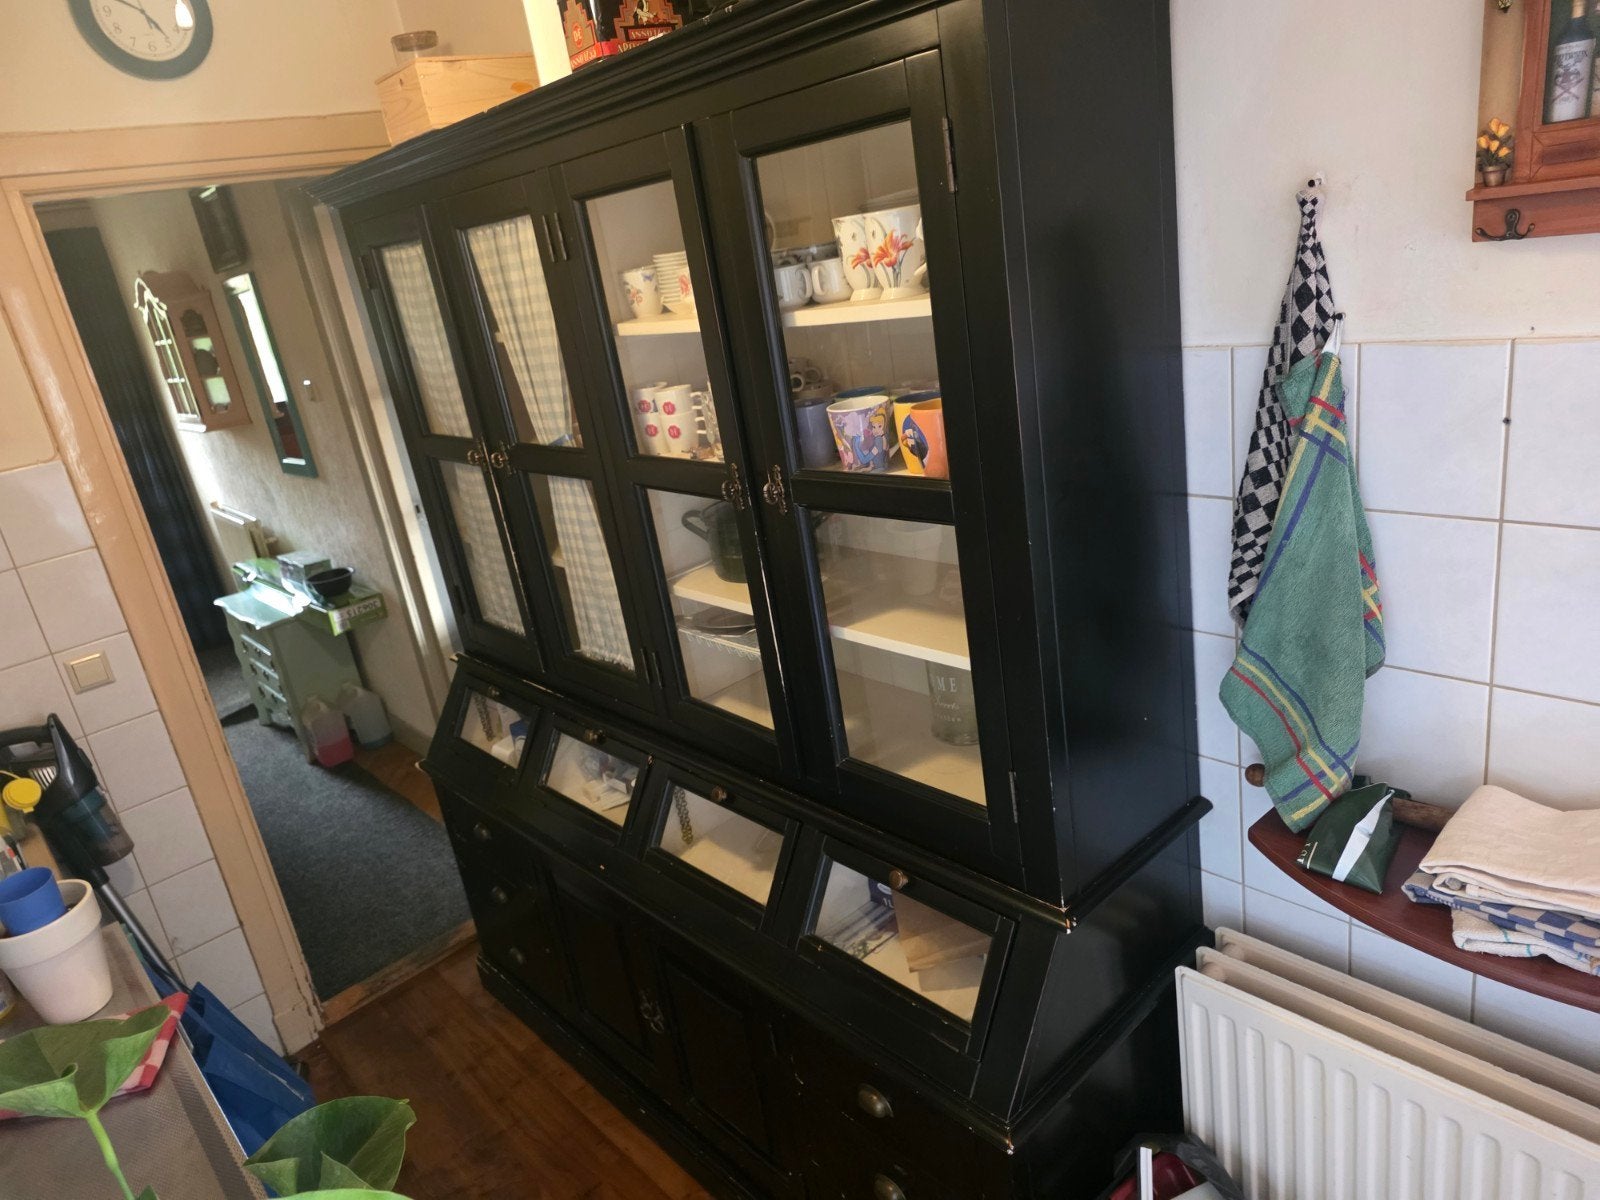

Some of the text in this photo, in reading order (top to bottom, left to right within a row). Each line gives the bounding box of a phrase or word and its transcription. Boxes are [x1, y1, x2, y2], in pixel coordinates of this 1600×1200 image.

[102, 5, 112, 18] 9
[112, 22, 122, 34] 8
[130, 36, 137, 47] 7
[147, 41, 157, 52] 6
